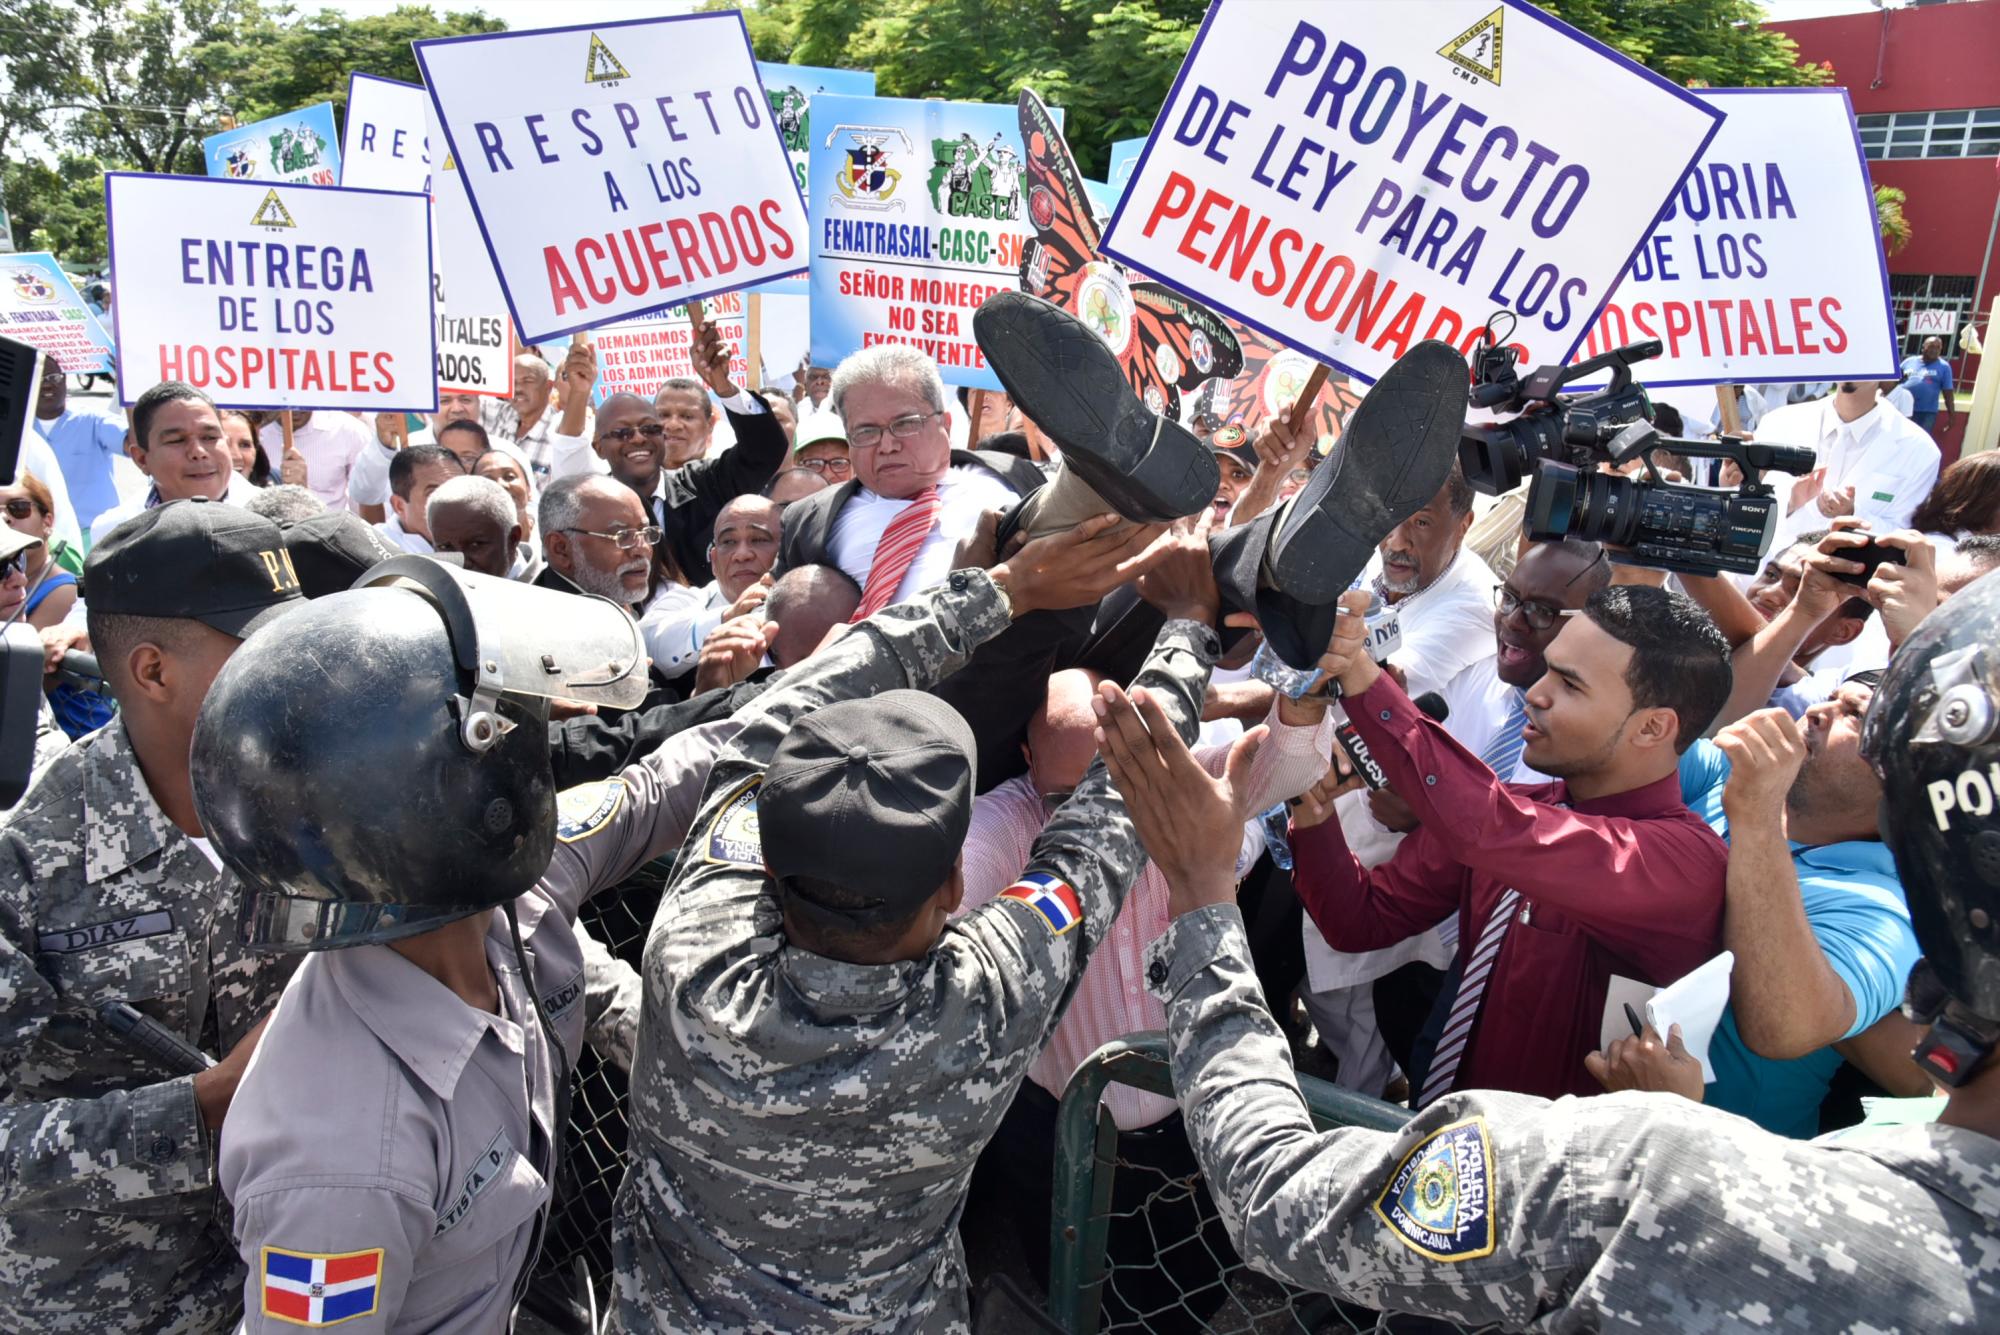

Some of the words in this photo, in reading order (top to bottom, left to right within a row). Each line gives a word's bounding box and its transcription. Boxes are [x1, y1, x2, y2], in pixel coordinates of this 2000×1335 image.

[1454, 20, 1489, 47] COLEGIO
[1448, 52, 1494, 80] DOMINICANO
[474, 86, 761, 173] RESPETO
[1265, 19, 1589, 239] PROYECTO
[604, 170, 628, 213] A
[647, 157, 702, 203] LOS
[950, 192, 1009, 220] CASC
[1174, 85, 1251, 165] DE
[1251, 124, 1357, 212] LEY
[1355, 178, 1487, 285] PARA
[1488, 248, 1588, 333] LOS
[543, 198, 794, 316] ACUERDOS
[824, 217, 1031, 267] FENATRASAL-CASC-SN
[1632, 235, 1680, 282] DE
[1694, 233, 1768, 280] LOS
[181, 238, 373, 292] ENTREGA
[1142, 171, 1530, 386] PENSIONAD
[839, 269, 904, 300] SEÑOR
[910, 278, 1013, 308] MONEGR
[218, 295, 258, 331] DE
[275, 298, 334, 335] LOS
[441, 314, 501, 347] ITALES
[889, 306, 915, 331] NO
[922, 309, 959, 336] SEA
[1914, 312, 1951, 331] TAXI
[597, 330, 688, 350] DEMANDAMOS
[605, 352, 621, 366] DE
[624, 349, 647, 364] LOS
[159, 344, 395, 393] HOSPITALES
[602, 367, 625, 382] LOS
[1741, 505, 1768, 514] SONY
[65, 919, 140, 949] DIAZ
[544, 983, 581, 1014] OLICIA
[1454, 1133, 1470, 1242] NACIONAL
[1466, 1140, 1484, 1222] POLICIA
[434, 1172, 485, 1235] ATISTA
[1391, 1206, 1451, 1250] DOMINICANA
